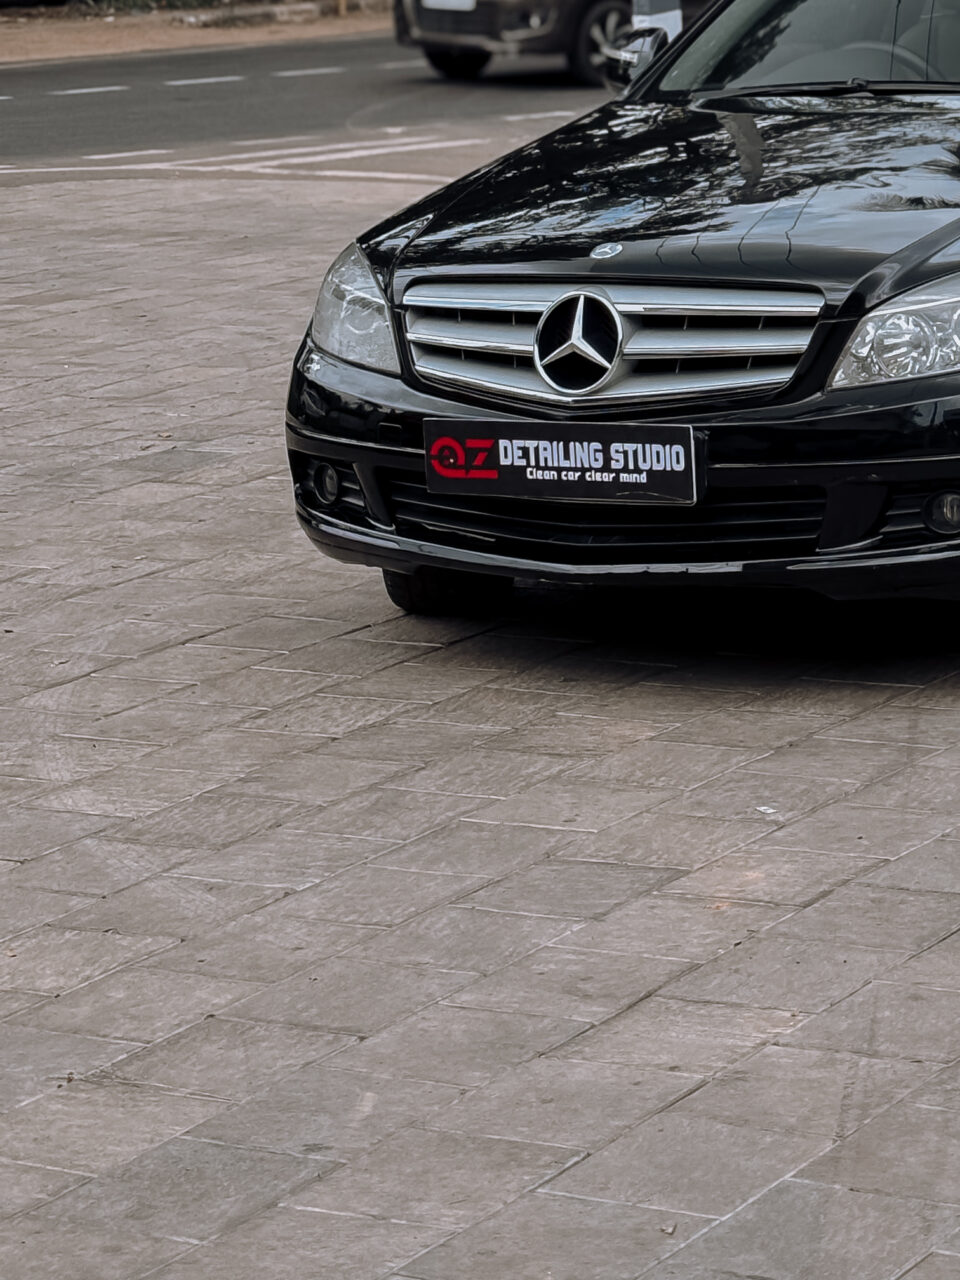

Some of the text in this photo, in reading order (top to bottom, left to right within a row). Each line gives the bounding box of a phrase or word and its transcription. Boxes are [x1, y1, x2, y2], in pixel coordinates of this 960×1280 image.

[499, 439, 603, 468] DETAILING
[610, 443, 685, 471] STUDIO
[526, 467, 647, 483] Clean car clear mind
